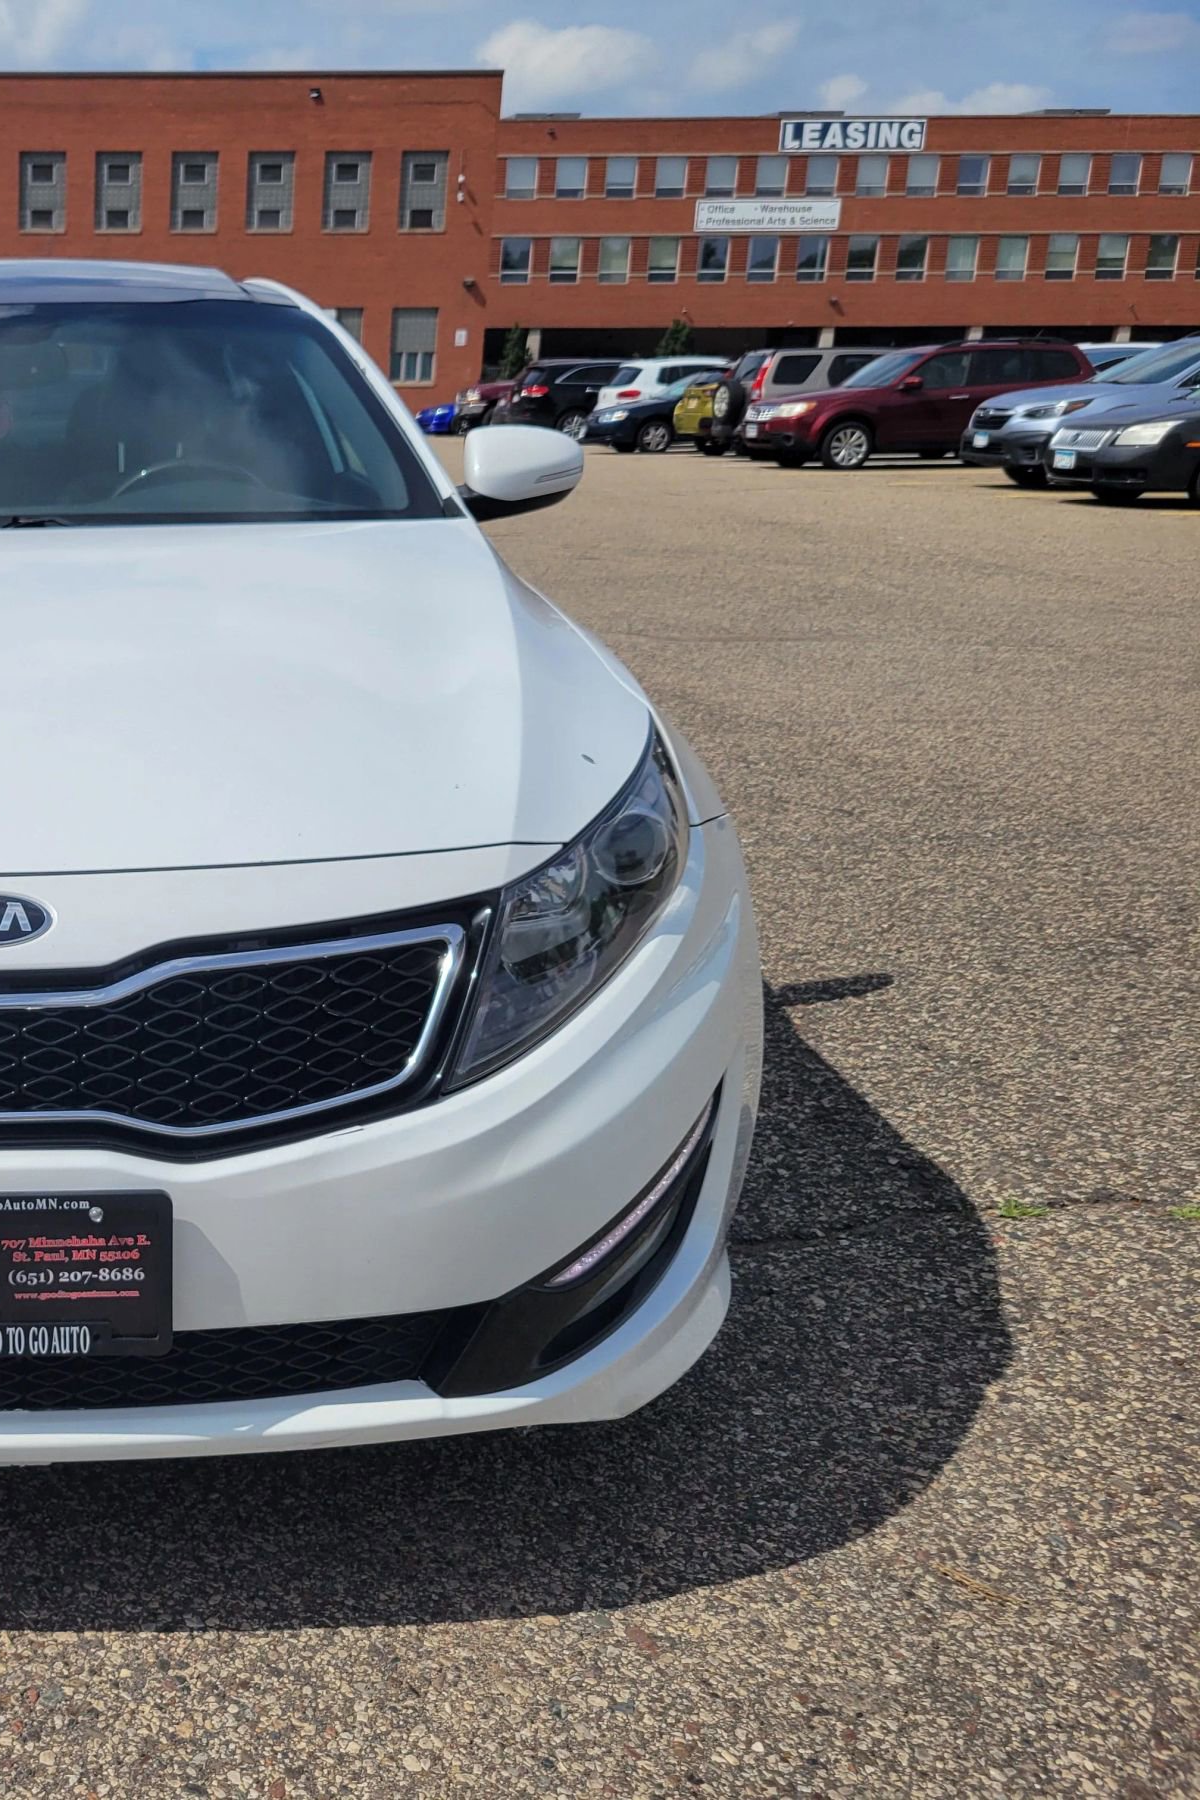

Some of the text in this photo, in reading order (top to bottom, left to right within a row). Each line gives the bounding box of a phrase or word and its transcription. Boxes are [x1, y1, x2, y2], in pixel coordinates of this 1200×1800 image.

[784, 122, 922, 149] LEASING
[707, 203, 812, 214] Office Warehouse
[705, 216, 836, 226] Professional Arts & Science
[1, 1240, 26, 1250] 707
[108, 1235, 134, 1246] Ave
[12, 1248, 140, 1262] St. Paul, MN 55106
[8, 1266, 145, 1286] (651) 207-8686
[6, 1326, 26, 1355] TO
[29, 1326, 49, 1356] GO
[50, 1325, 91, 1354] AUTO
